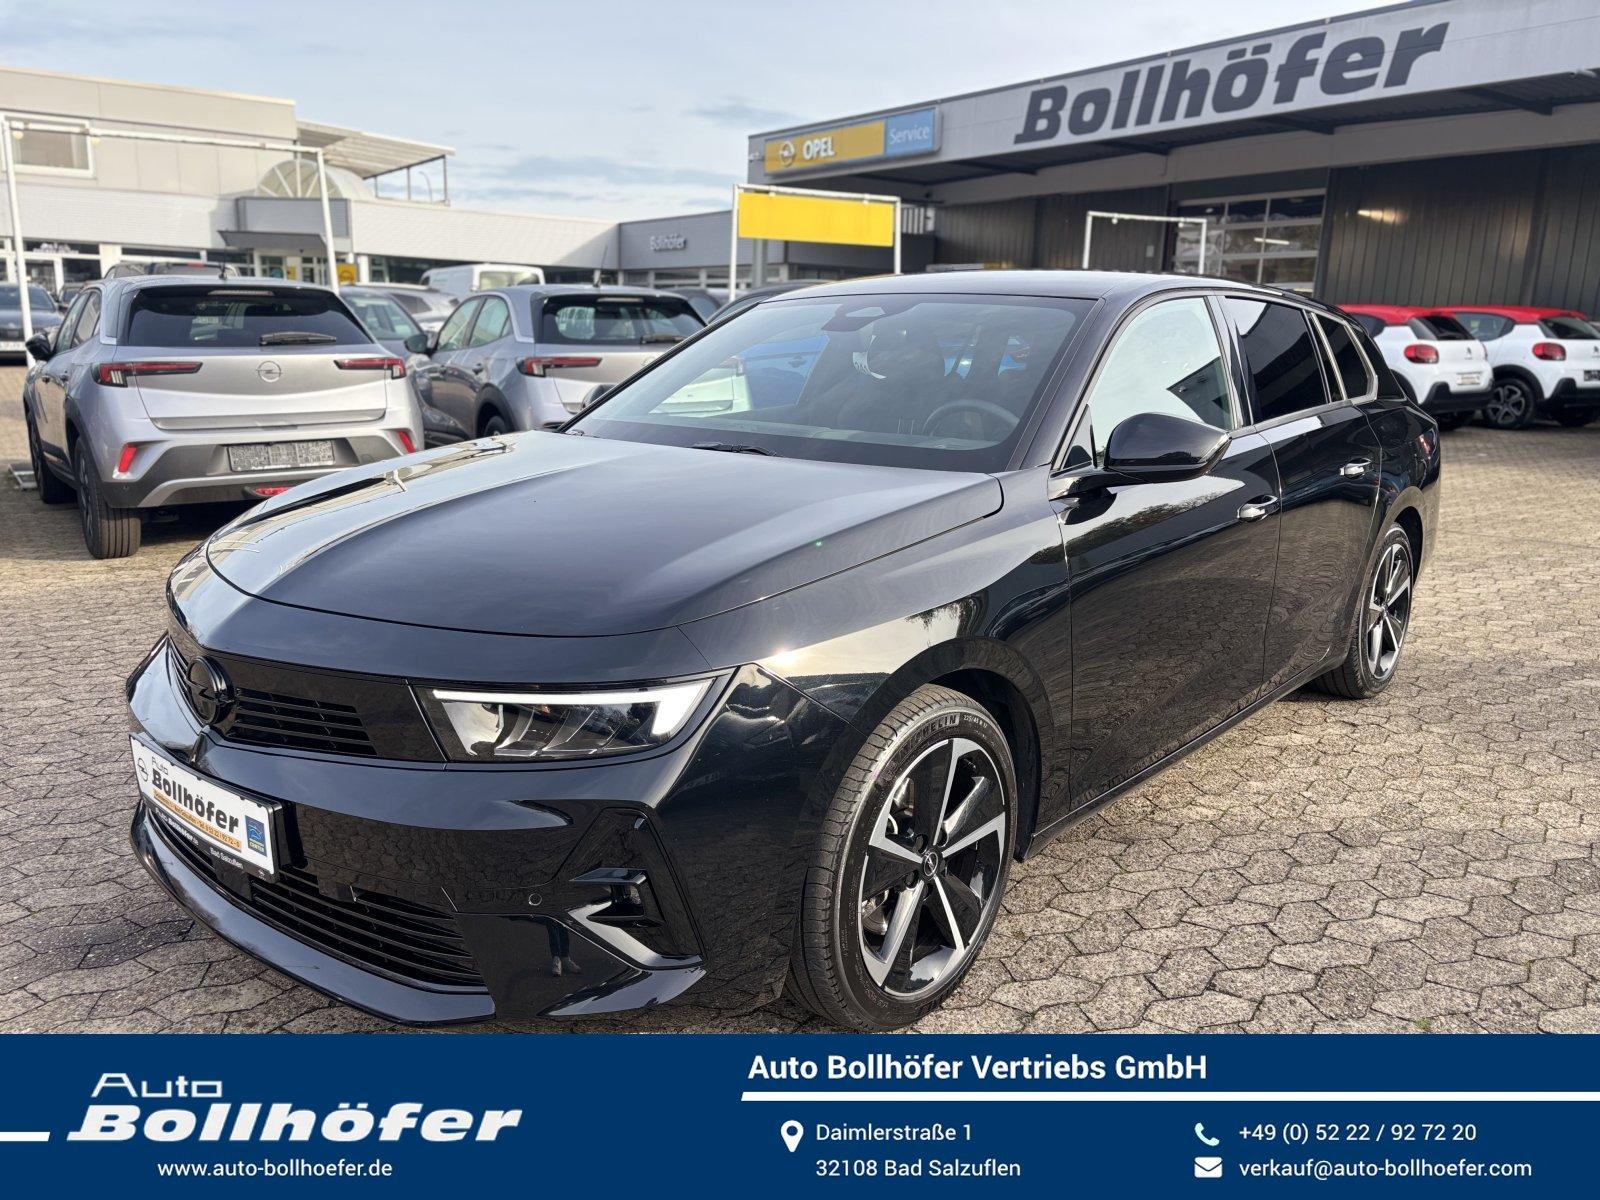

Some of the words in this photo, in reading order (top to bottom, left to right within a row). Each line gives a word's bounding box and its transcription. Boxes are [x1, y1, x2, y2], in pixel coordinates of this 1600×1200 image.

[1013, 22, 1449, 144] Bollhöfer
[803, 136, 835, 160] OPEL
[890, 124, 930, 144] Service
[151, 756, 169, 776] Auto
[152, 768, 239, 834] Bollhöfer
